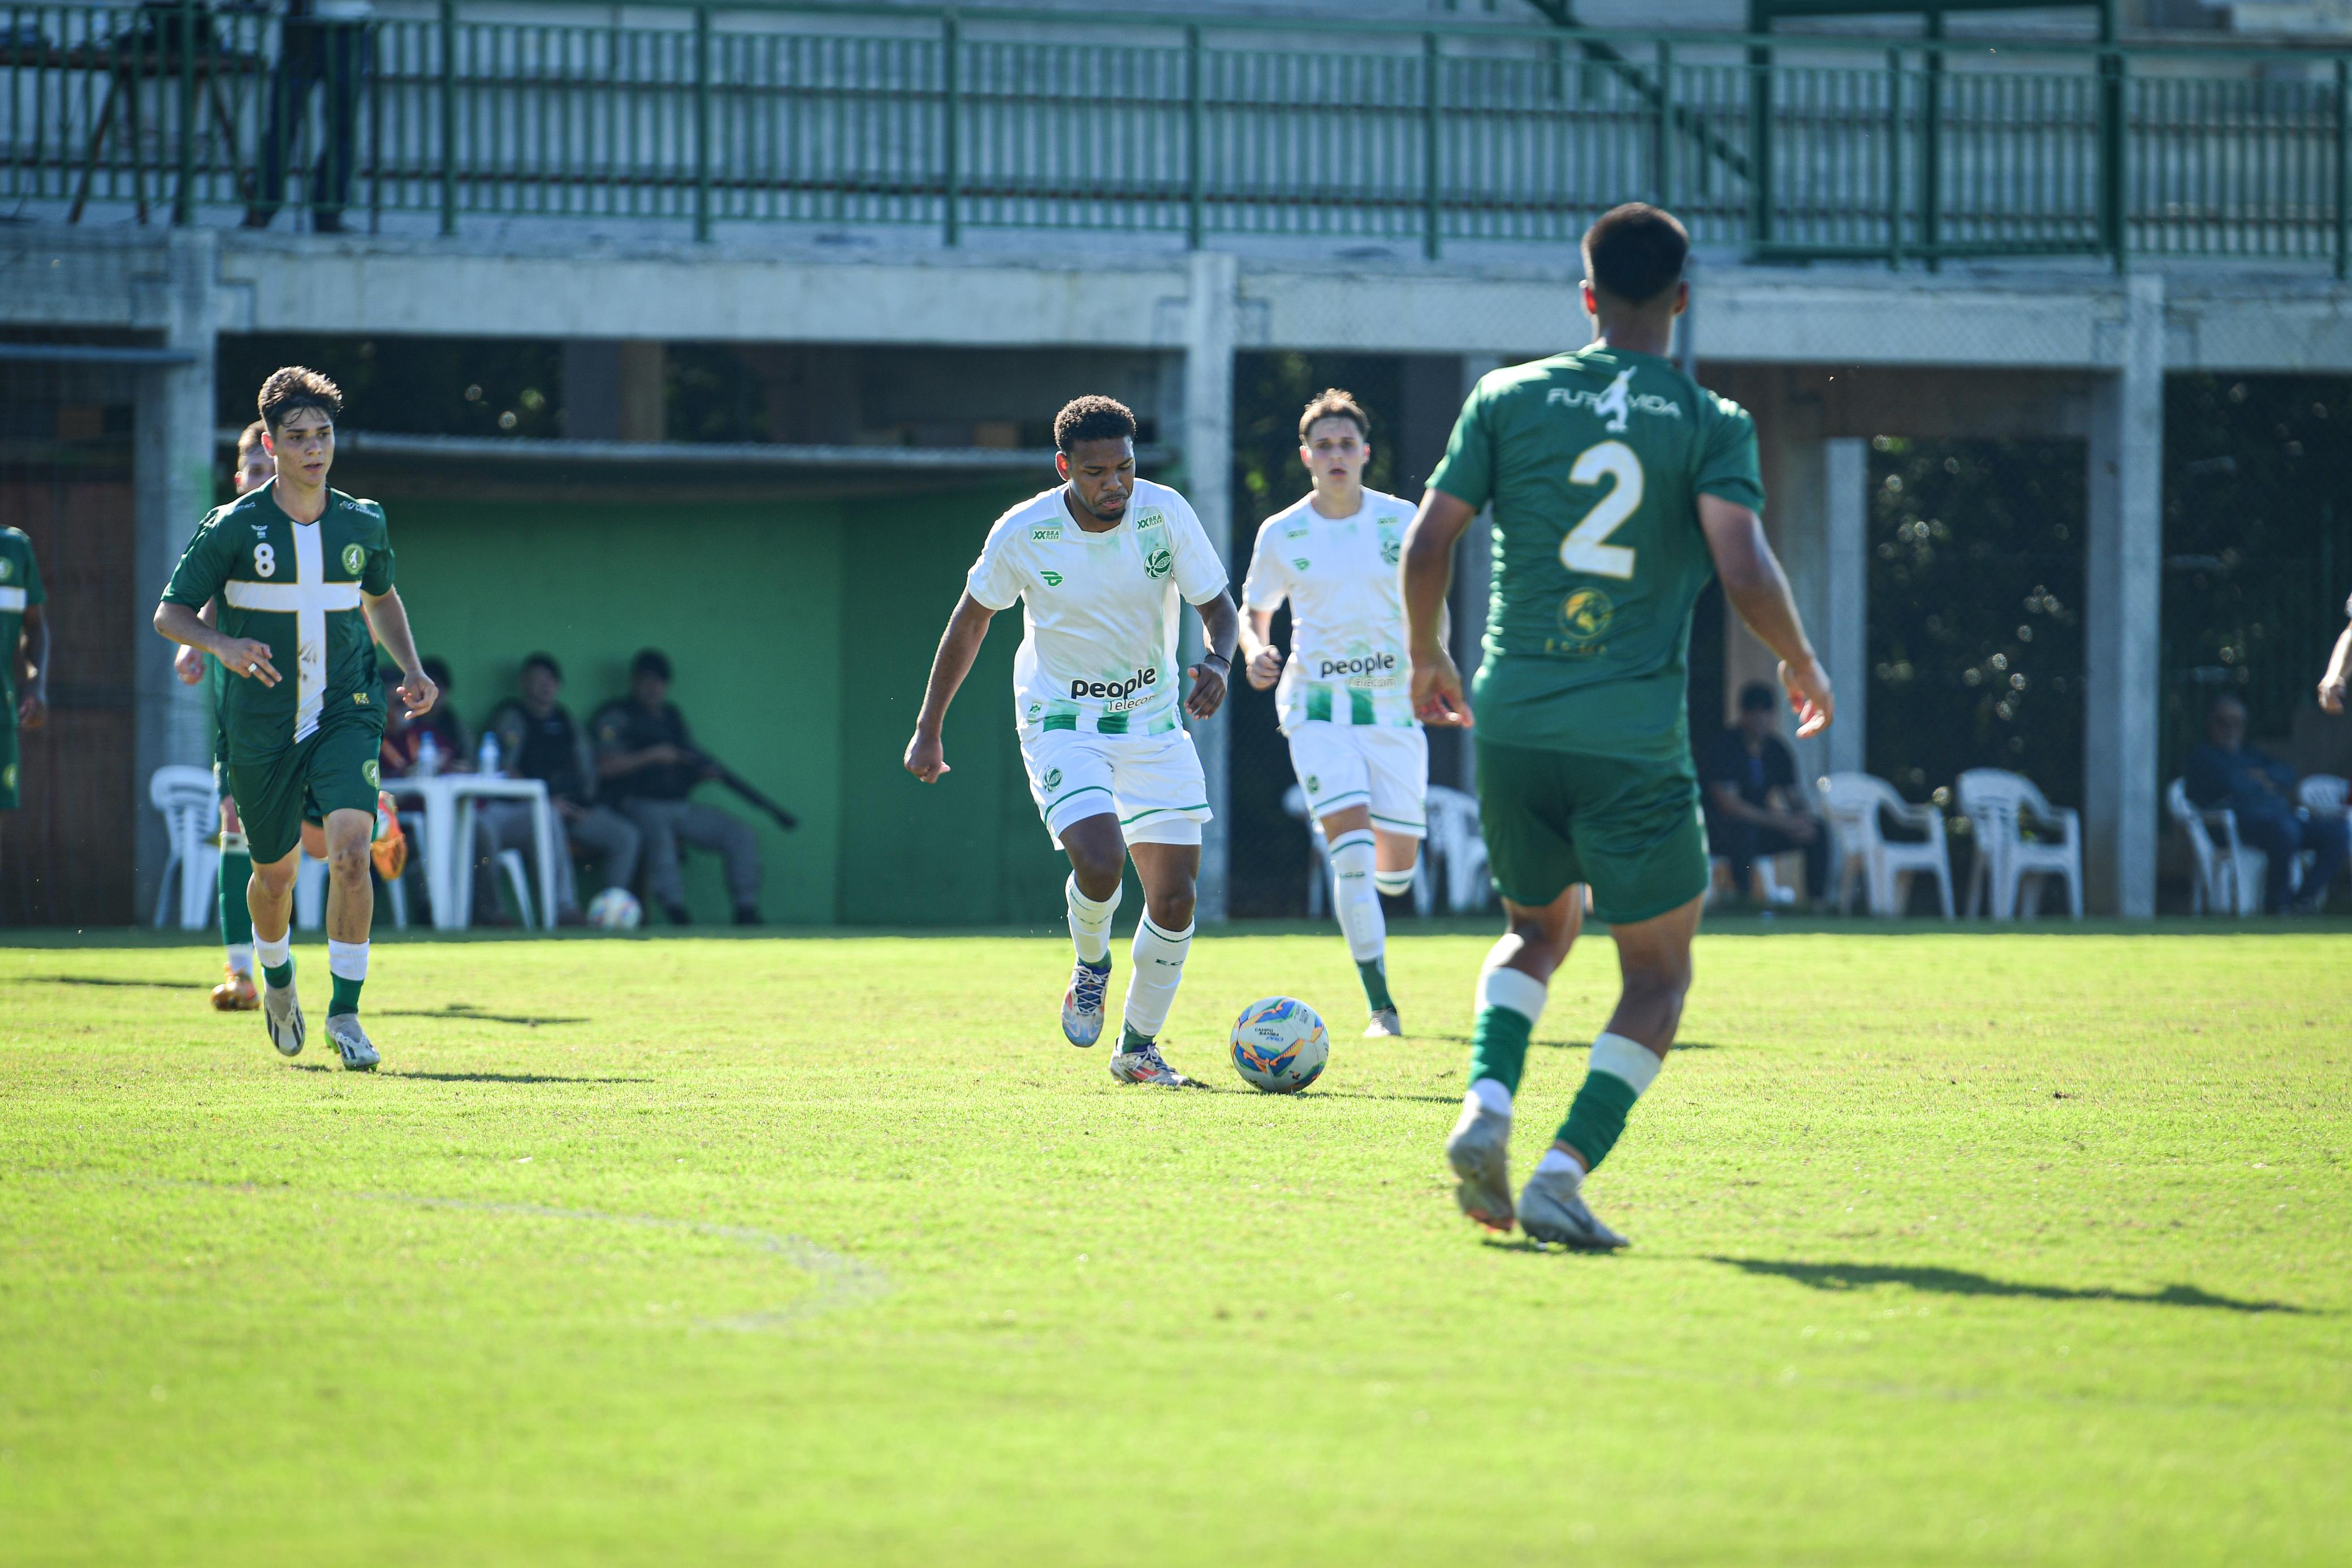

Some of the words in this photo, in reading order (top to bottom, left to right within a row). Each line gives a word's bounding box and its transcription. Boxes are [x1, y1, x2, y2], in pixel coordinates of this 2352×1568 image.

[1559, 439, 1644, 580] 2
[253, 543, 275, 578] 8
[1321, 653, 1394, 678] people
[1071, 668, 1156, 699] people
